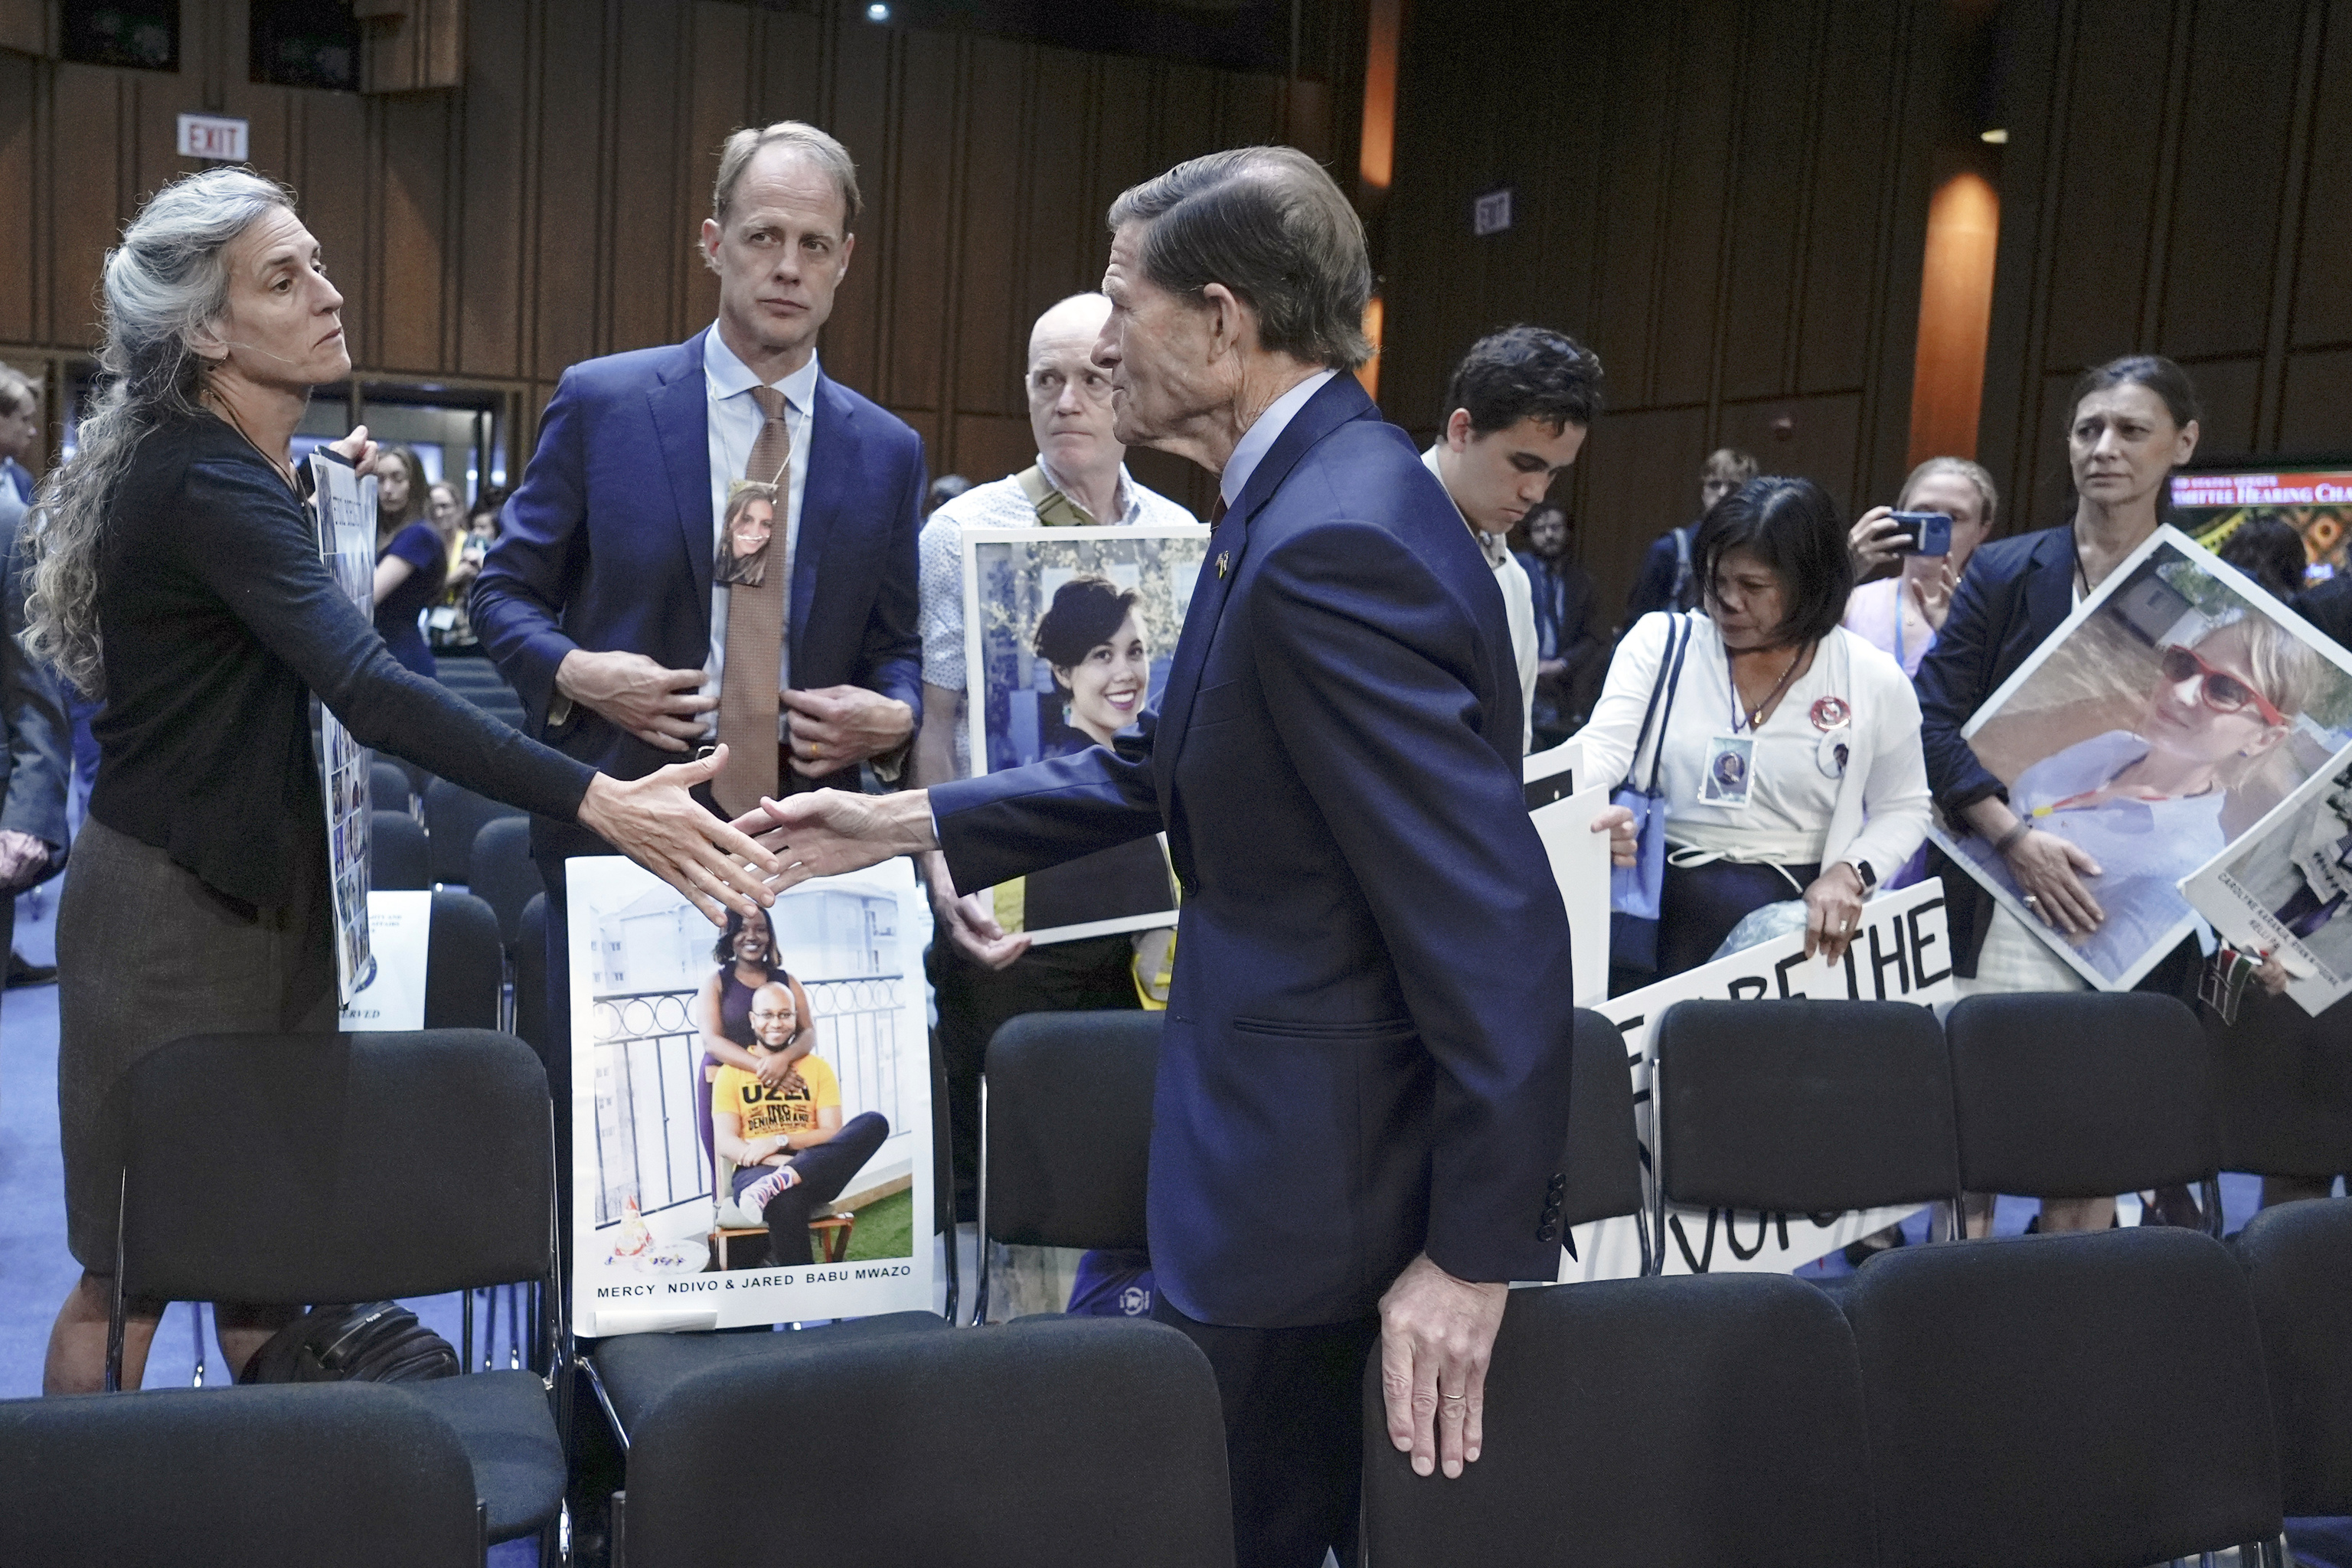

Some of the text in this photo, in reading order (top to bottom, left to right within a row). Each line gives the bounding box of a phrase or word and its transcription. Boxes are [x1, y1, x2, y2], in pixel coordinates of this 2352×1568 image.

[189, 124, 237, 157] EXIT
[1844, 897, 1952, 1001] THE
[341, 1010, 380, 1018] ERVED
[597, 1266, 910, 1298] MERCY NDIVO & JARED BABU MWAZO
